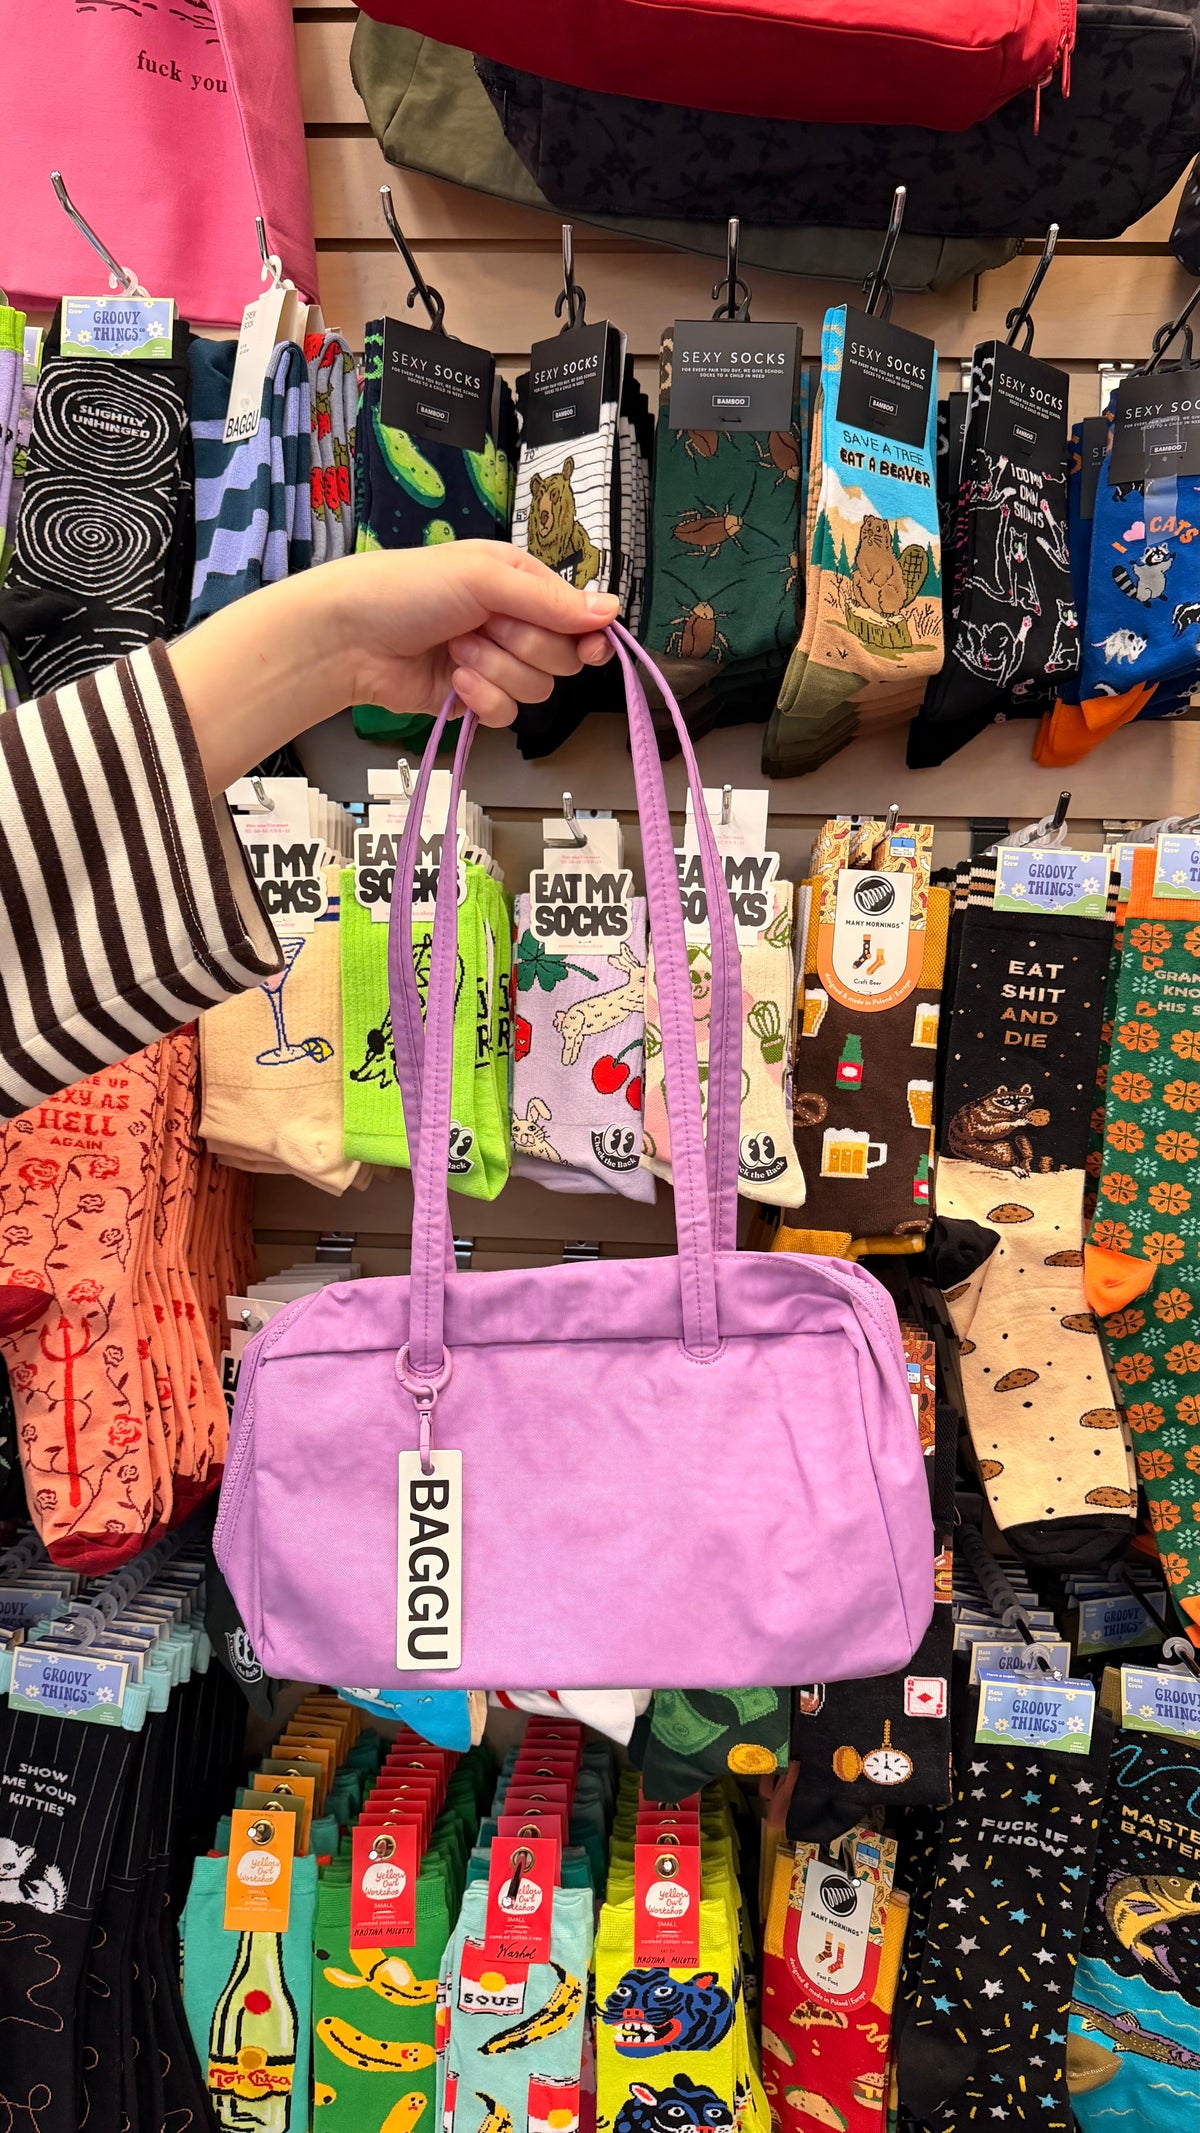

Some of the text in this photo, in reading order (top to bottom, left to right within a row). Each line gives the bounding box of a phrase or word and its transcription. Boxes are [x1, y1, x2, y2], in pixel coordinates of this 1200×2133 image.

[137, 50, 228, 93] fuck you
[93, 310, 141, 325] GROOVY
[681, 351, 785, 365] SEXY SOCKS
[851, 341, 926, 381] SEXY SOCKS
[392, 350, 481, 389] SEXY SOCKS
[534, 355, 598, 385] SEXY SOCKS
[999, 373, 1026, 393] SEXY
[1030, 386, 1063, 411] SOCKS
[420, 406, 446, 419] BAMBOO
[555, 408, 574, 419] BAMBOO
[872, 399, 894, 412] BAMBOO
[1125, 404, 1163, 420] SEXY
[80, 404, 146, 428] SLIGHTLY
[226, 408, 259, 438] BAGGU
[72, 413, 150, 439] UNHINGED
[1015, 428, 1034, 440] BAMBOO
[843, 430, 925, 467] SAVE A TREE
[1153, 444, 1182, 453] BAMBOO
[839, 446, 931, 488] EAT A BEAVER
[1010, 462, 1016, 478] I
[1015, 466, 1030, 483] DO
[1013, 500, 1045, 529] STUNTS
[1150, 516, 1199, 543] CATS
[272, 844, 320, 878] MY
[725, 856, 772, 890] MY
[1028, 863, 1078, 880] GROOVY
[260, 879, 322, 915] CKS
[535, 873, 628, 904] EAT MY
[1027, 880, 1074, 897] THINGS
[535, 905, 628, 937] SOCKS
[865, 921, 901, 929] MORNINGS
[1008, 960, 1064, 980] EAT
[1000, 983, 1066, 1003] SHIT
[1163, 985, 1200, 998] KNO
[1000, 1007, 1058, 1026] AND
[1157, 1001, 1187, 1013] HIS
[1004, 1030, 1048, 1048] DIE
[109, 1078, 129, 1088] UP
[101, 1094, 130, 1110] AS
[37, 1107, 117, 1137] HELL
[50, 1136, 103, 1150] AGAIN
[604, 1158, 617, 1168] the
[617, 1157, 637, 1168] Back
[750, 1160, 785, 1179] the Back
[408, 1479, 449, 1660] BAGGU
[1104, 1607, 1141, 1623] GROOVY
[42, 1666, 92, 1687] GROOVY
[1012, 1699, 1062, 1717] GROOVY
[1011, 1715, 1058, 1734] THINGS
[18, 1762, 69, 1783] SHOW
[2, 1774, 77, 1806] ME YOUR
[8, 1792, 65, 1817] KITTIES
[981, 1817, 1069, 1843] FUCK IF
[866, 1848, 871, 1856] L
[977, 1831, 1065, 1858] I KNOW
[251, 1856, 280, 1868] Yellow
[257, 1866, 274, 1875] Owl
[376, 1869, 405, 1882] Yellow
[382, 1878, 399, 1888] Owl
[518, 1884, 541, 1894] ellow
[519, 1894, 536, 1903] Owl
[658, 1887, 689, 1901] Yellow
[665, 1898, 683, 1907] Owl
[810, 1911, 860, 1937] MANY MORNINGS
[789, 1957, 806, 1983] designed
[808, 1987, 823, 2000] made
[823, 1996, 830, 2004] in
[830, 1998, 848, 2006] Poland
[850, 1990, 867, 2004] Europe
[816, 1971, 827, 1981] Fast
[463, 1993, 519, 2007] SOUP
